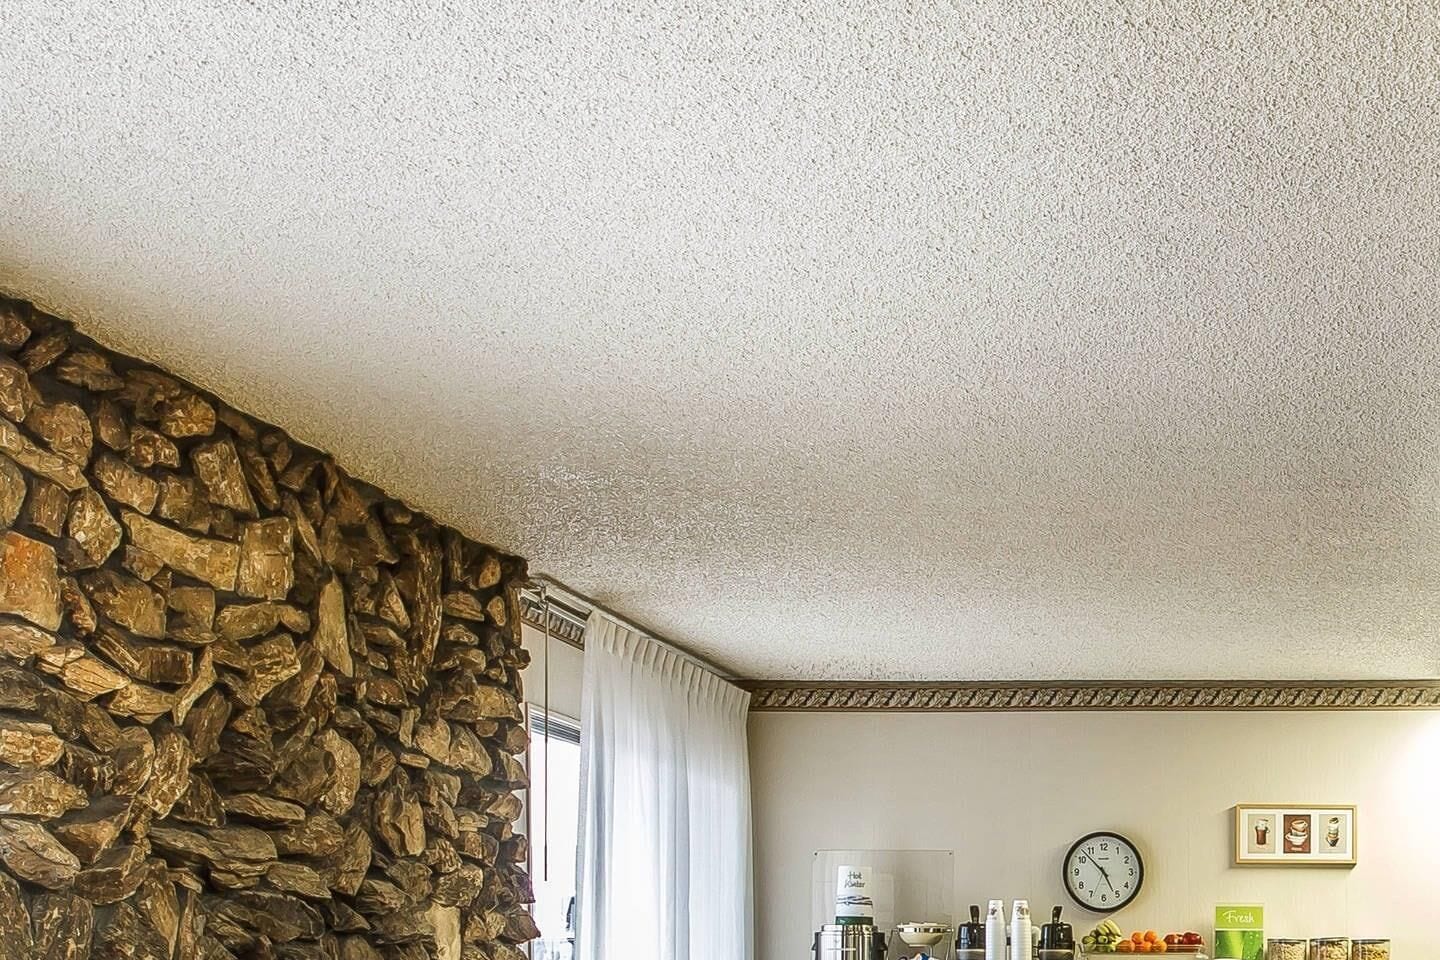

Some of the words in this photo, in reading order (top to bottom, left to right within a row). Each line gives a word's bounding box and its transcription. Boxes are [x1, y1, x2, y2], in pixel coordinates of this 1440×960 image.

[1087, 846, 1095, 855] 11
[1100, 842, 1109, 851] 12
[1078, 855, 1087, 864] 10
[1123, 855, 1130, 865] 2
[847, 871, 863, 880] Hot
[1074, 867, 1080, 876] 9
[1128, 867, 1134, 877] 3
[1078, 880, 1085, 890] 8
[1123, 881, 1129, 890] 4
[1088, 889, 1094, 898] 7
[1101, 893, 1107, 902] 6
[1114, 889, 1121, 898] 5
[1222, 909, 1255, 924] Fresh
